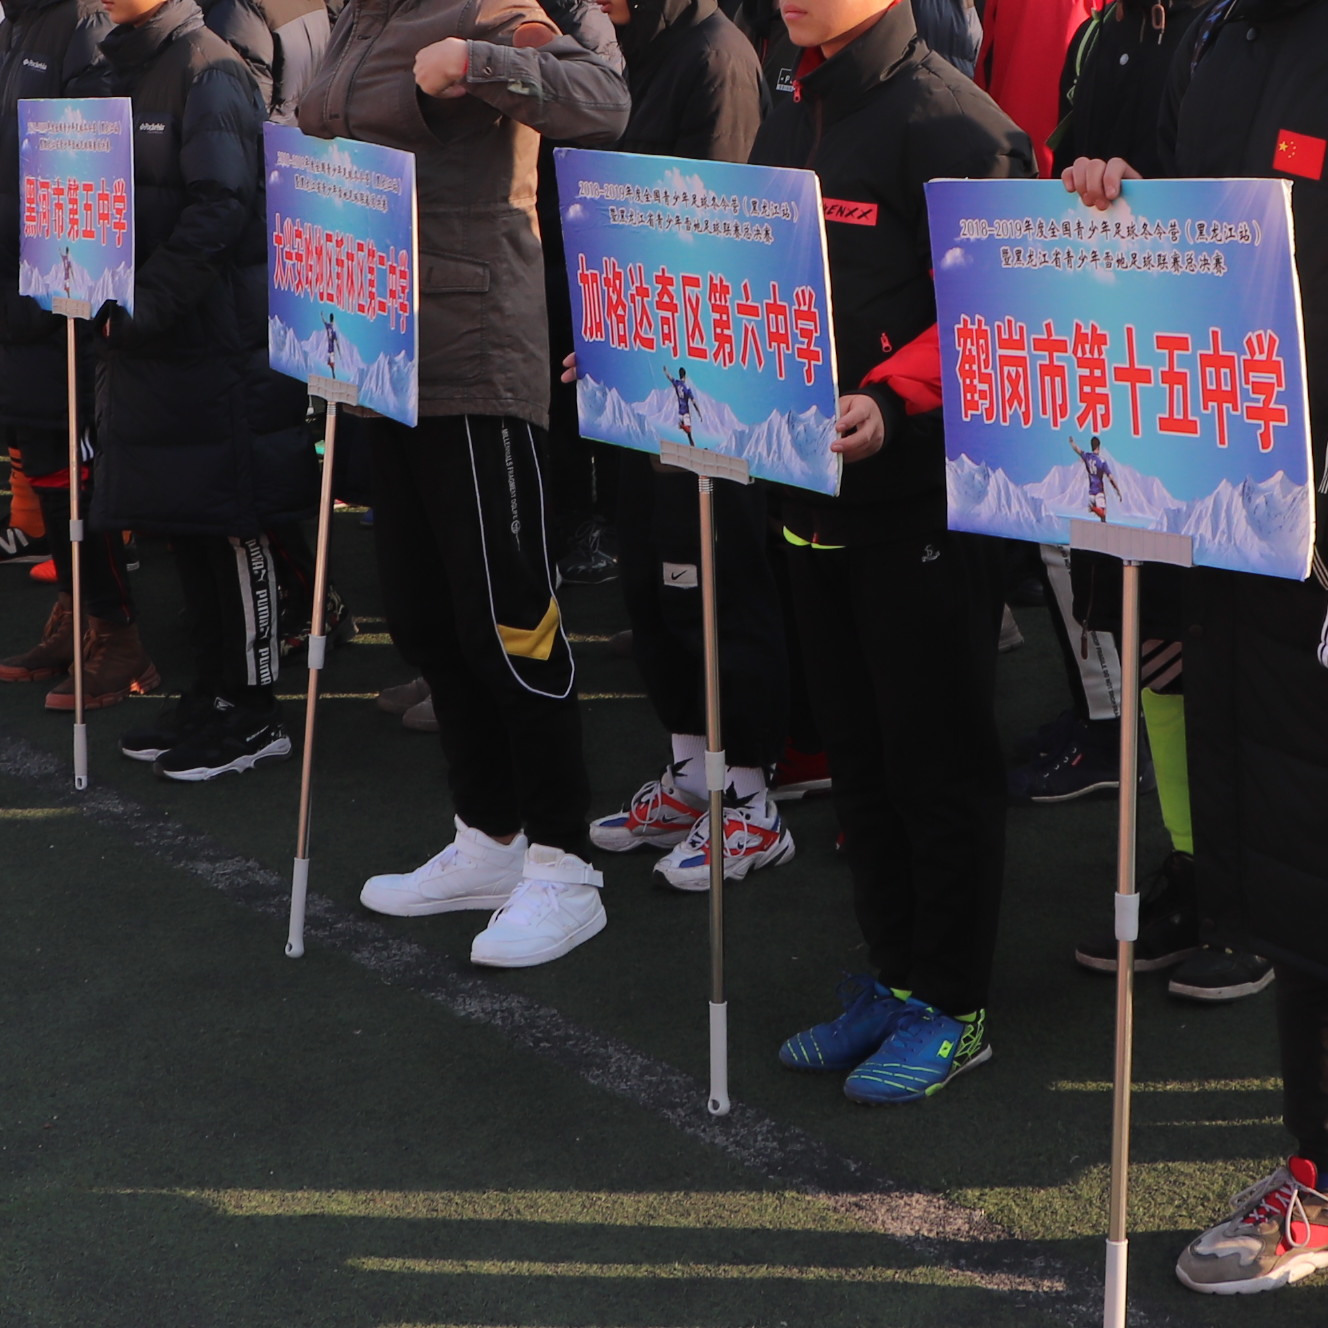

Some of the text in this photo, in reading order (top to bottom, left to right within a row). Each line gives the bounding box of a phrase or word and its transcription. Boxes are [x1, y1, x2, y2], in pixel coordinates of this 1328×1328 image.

[23, 174, 128, 247] 黑河市第五中学
[272, 212, 410, 334] 大兴安岭地区新林区第二中学
[577, 252, 823, 386] 加格达奇区第六中学
[953, 312, 1289, 453] 鹤岗市第十五中学
